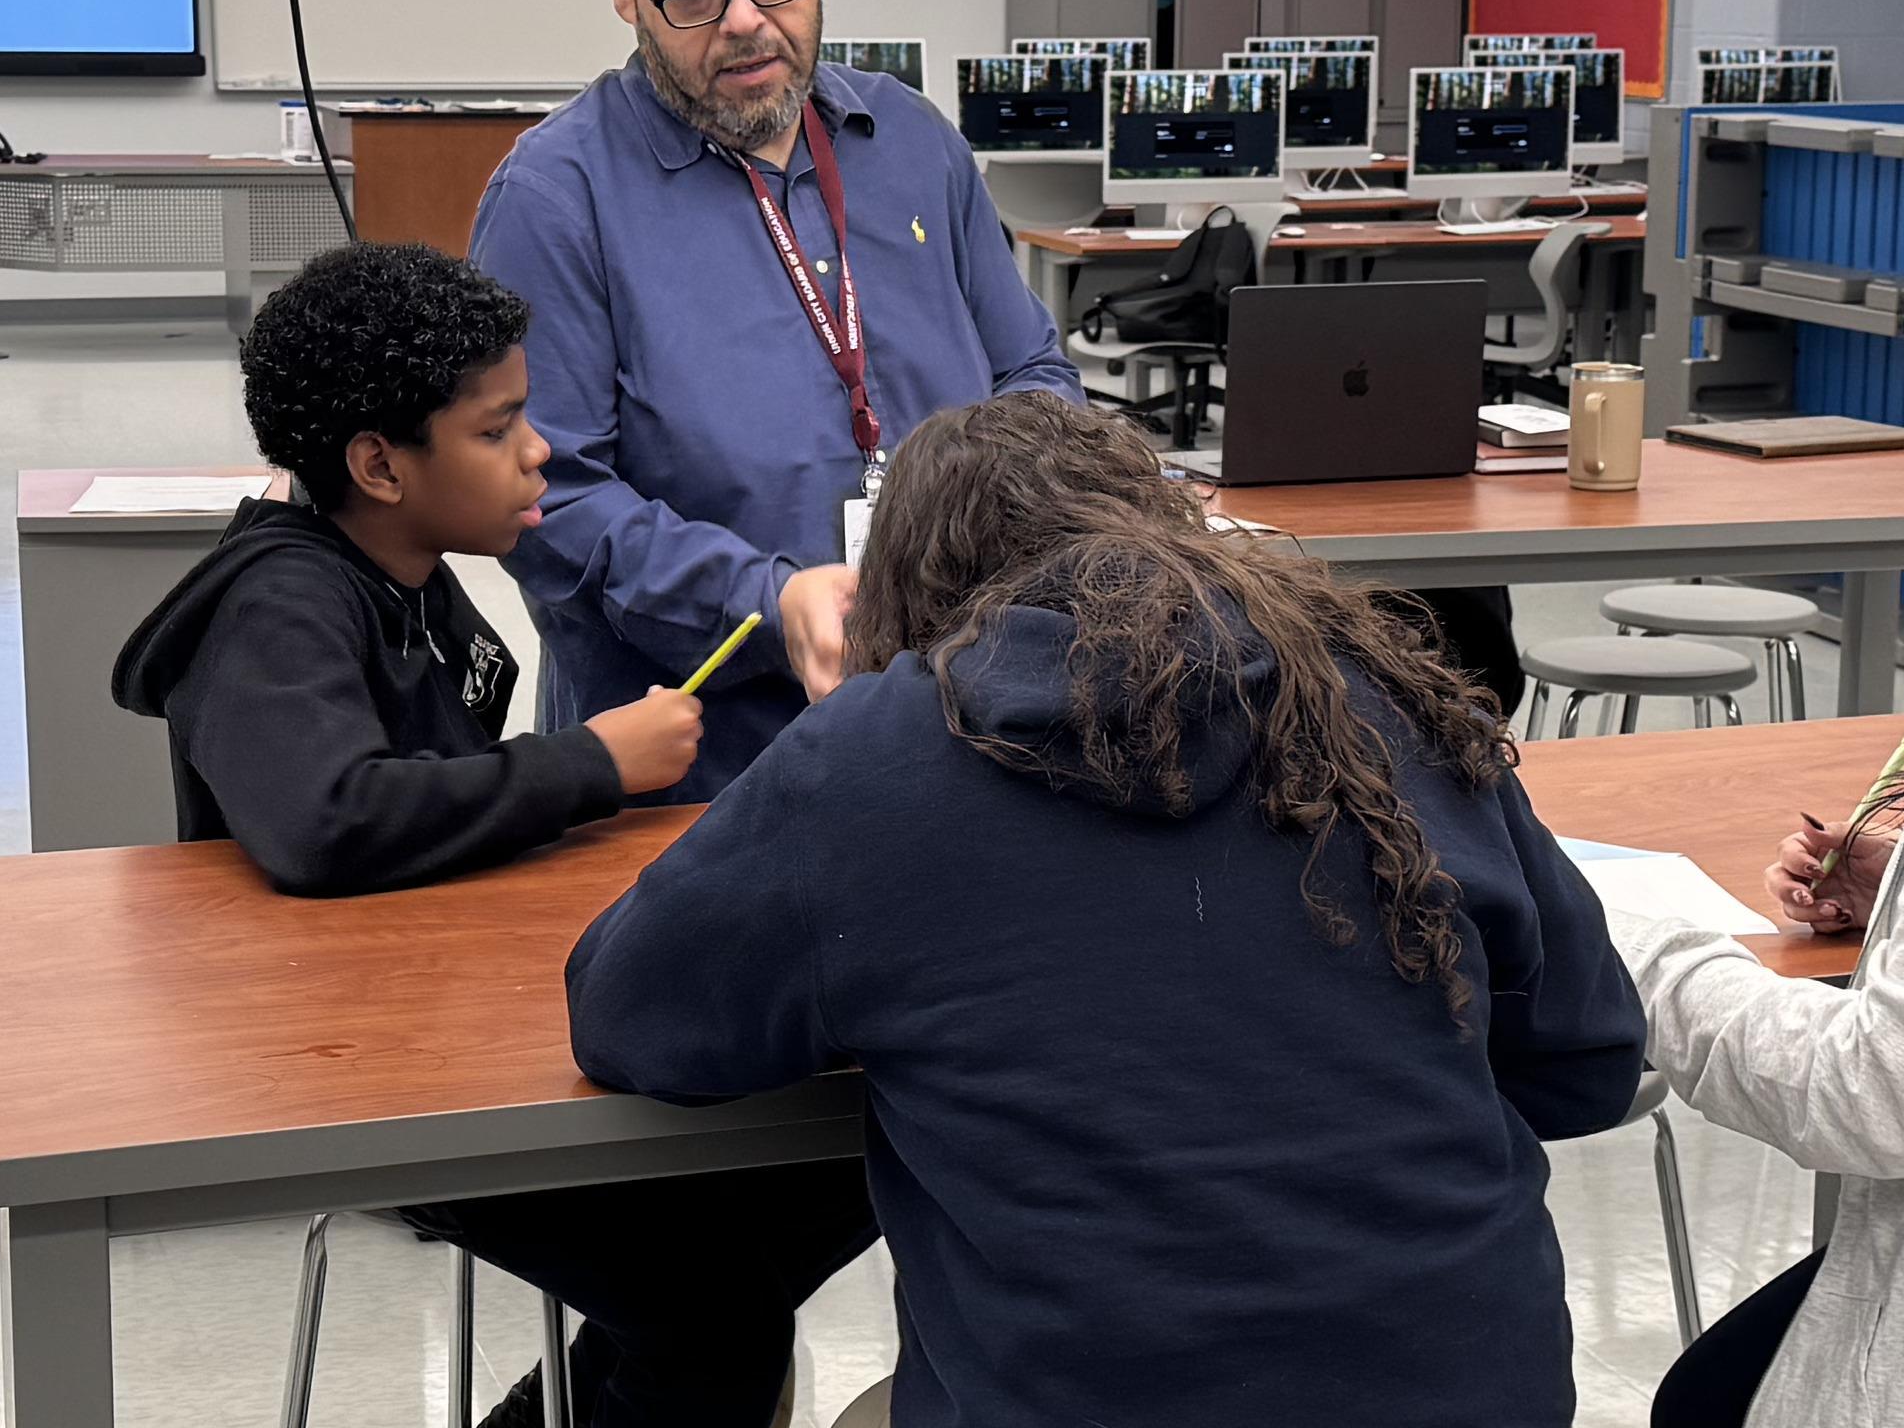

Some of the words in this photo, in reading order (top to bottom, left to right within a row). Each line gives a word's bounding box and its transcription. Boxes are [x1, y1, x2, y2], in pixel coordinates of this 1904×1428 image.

[761, 196, 793, 252] EDUCATION
[794, 265, 817, 302] BOARD
[811, 300, 827, 323] CITY
[822, 322, 841, 355] UNION
